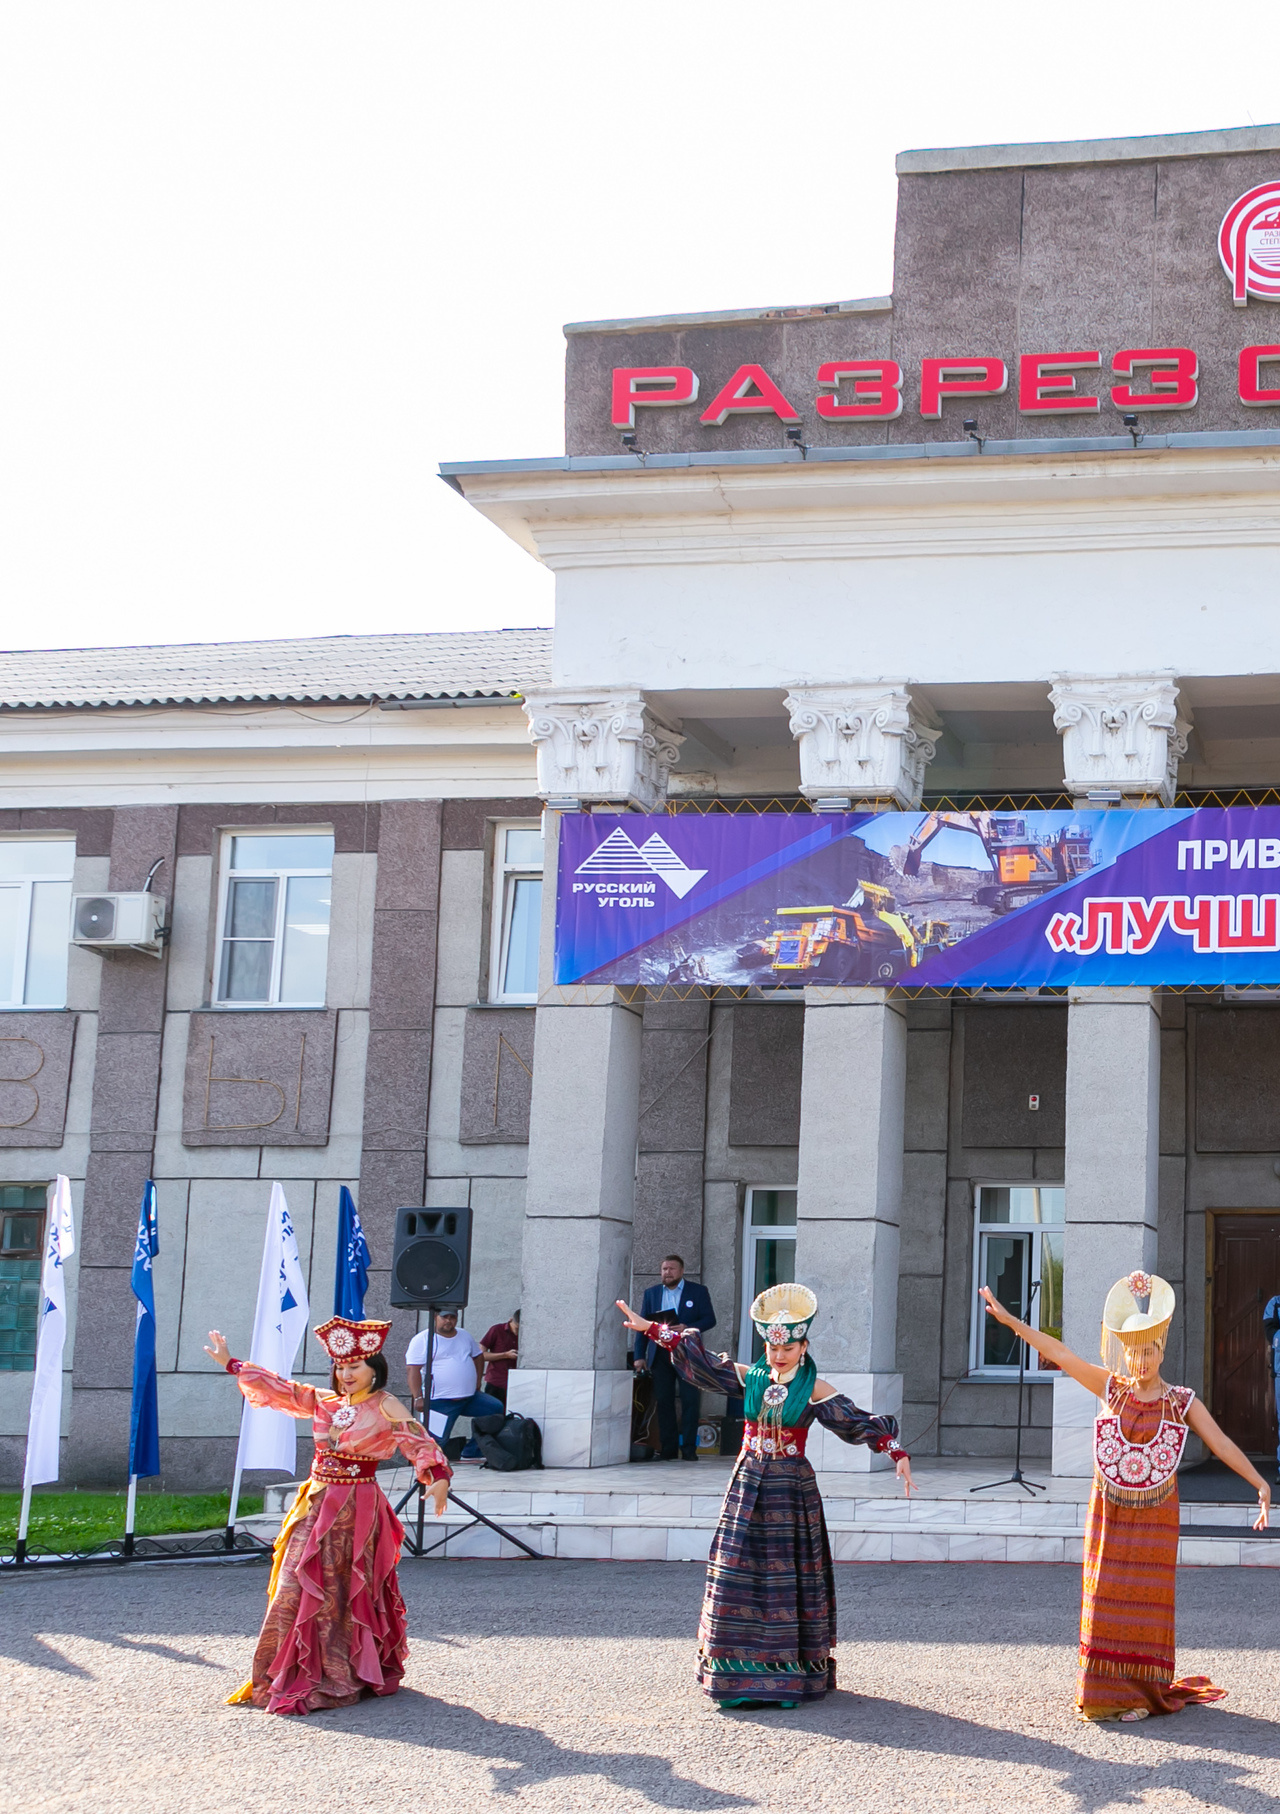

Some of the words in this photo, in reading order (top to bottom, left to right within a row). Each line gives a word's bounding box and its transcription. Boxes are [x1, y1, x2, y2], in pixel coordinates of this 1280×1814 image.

[612, 348, 1199, 429] РАЗРЕЗ
[572, 881, 656, 894] РУССКИЙ
[597, 897, 655, 908] УГОЛЬ
